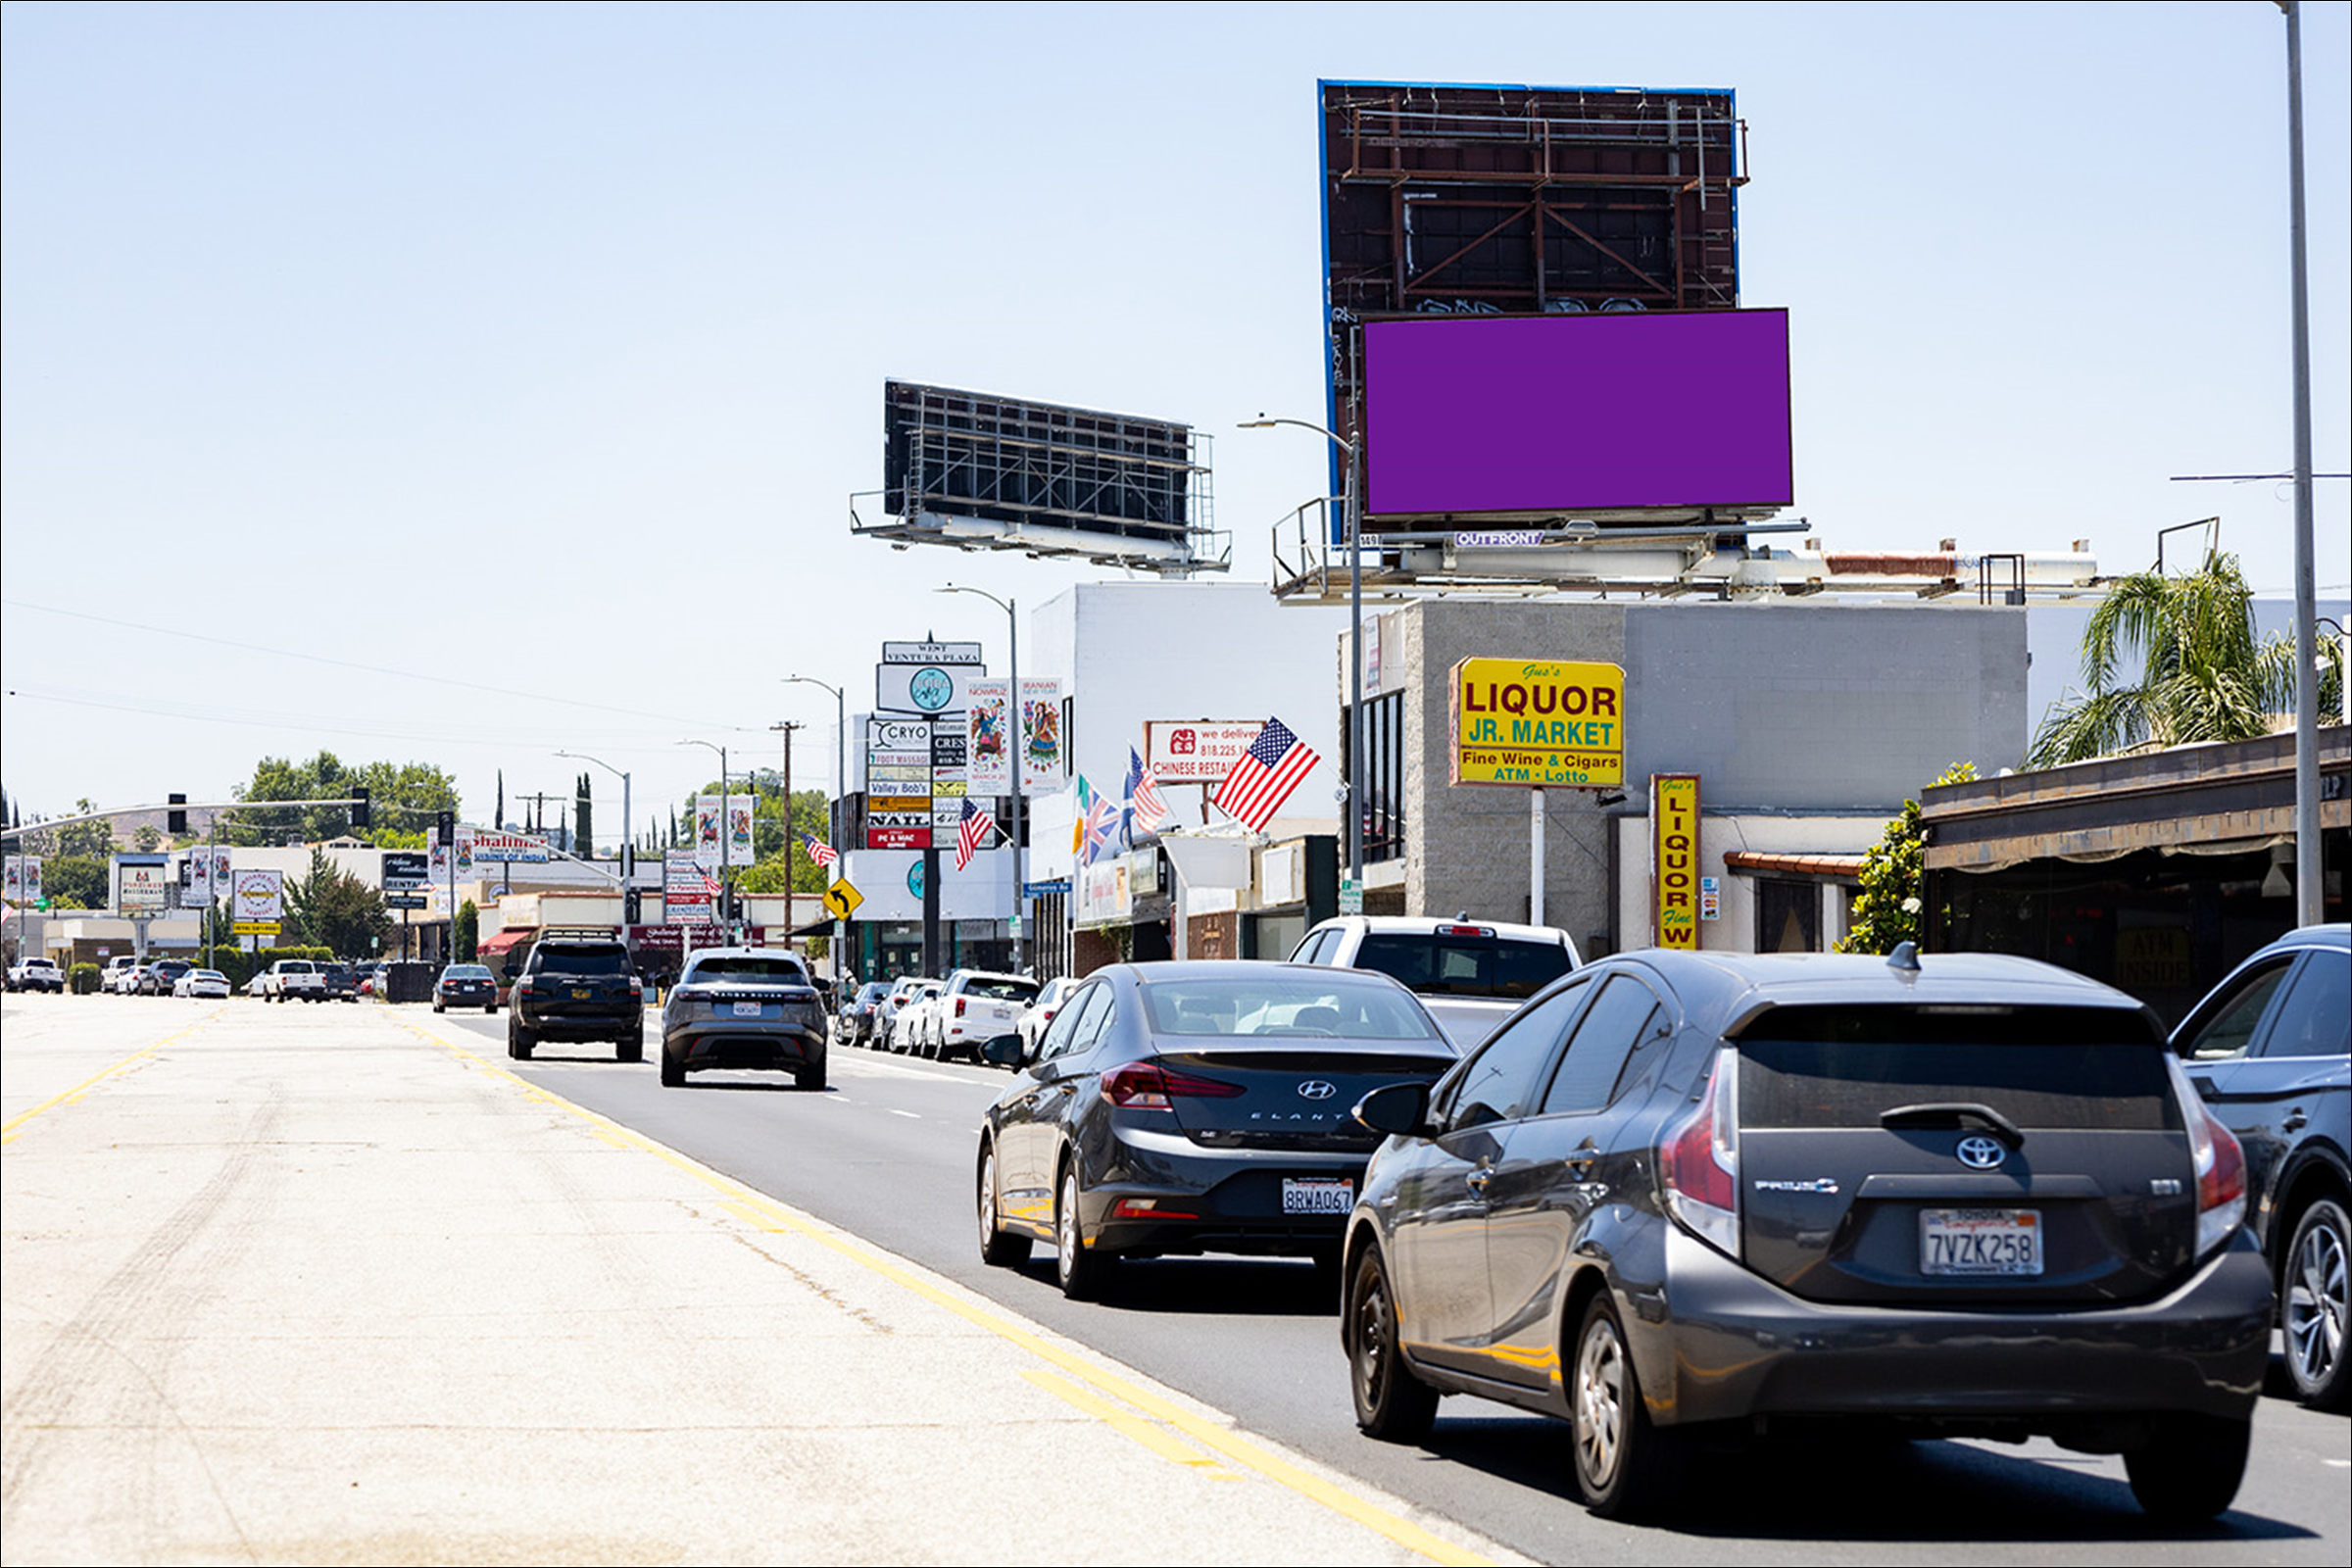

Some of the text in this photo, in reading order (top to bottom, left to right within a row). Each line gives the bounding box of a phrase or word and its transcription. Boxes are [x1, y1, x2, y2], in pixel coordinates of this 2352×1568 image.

[1456, 533, 1538, 547] OUTFRONT
[887, 653, 940, 662] VENTURA
[1522, 663, 1560, 680] Gus's
[1466, 682, 1616, 716] LIQUOR
[887, 725, 928, 739] CRYO
[1468, 718, 1614, 746] JR. MARKET
[934, 738, 966, 749] CRES
[876, 755, 928, 764] FOOT MASSAGE
[1462, 752, 1618, 769] Fine Wine & Cigars
[1152, 761, 1235, 775] CHINESE RESTAU
[1494, 767, 1589, 783] ATM Lotto
[871, 783, 898, 795] Valley
[902, 783, 927, 794] Bob's
[869, 816, 930, 826] NAIL
[474, 853, 505, 861] UISINE
[1664, 798, 1690, 906] LIQUOR
[1663, 909, 1691, 926] Fine
[2132, 933, 2174, 956] ATM
[2119, 960, 2188, 983] INSIDE
[1754, 1180, 1816, 1192] PRIUS
[1285, 1191, 1350, 1210] 8RWA067
[1957, 1209, 2004, 1219] TOYOTA
[1929, 1234, 2033, 1263] 7VZK258
